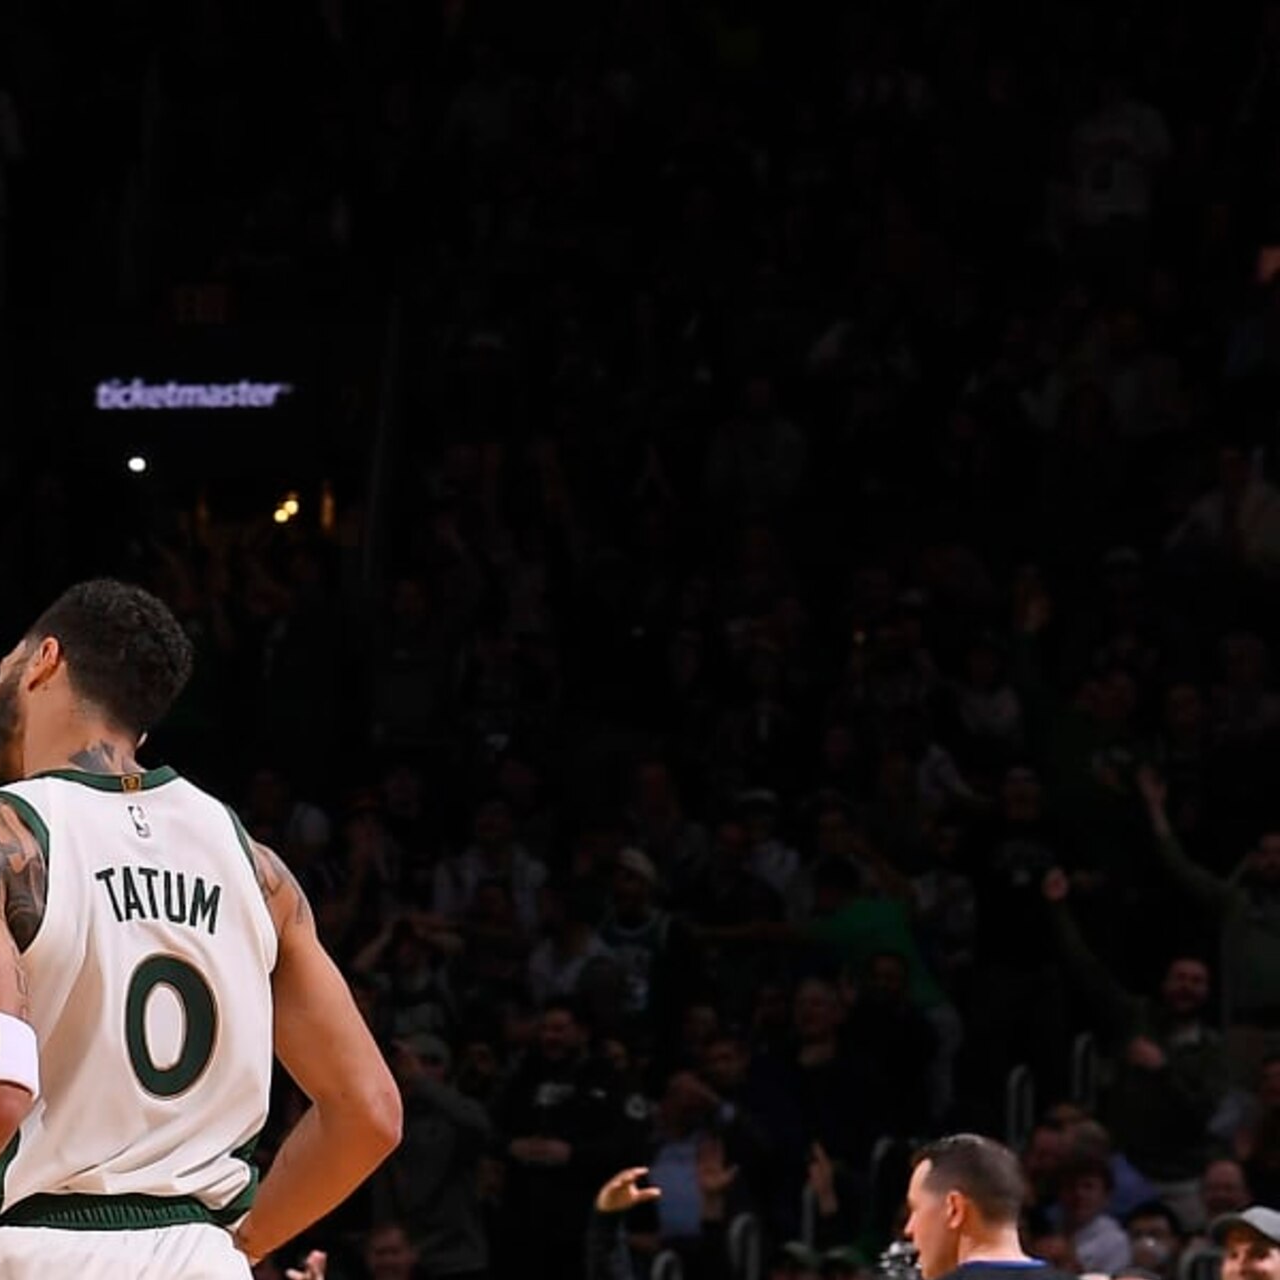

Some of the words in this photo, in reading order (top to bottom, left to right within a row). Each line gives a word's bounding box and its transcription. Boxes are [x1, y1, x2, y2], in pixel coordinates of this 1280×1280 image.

[97, 379, 281, 408] ticketmaster
[95, 866, 222, 934] TATUM
[126, 952, 218, 1099] 0
